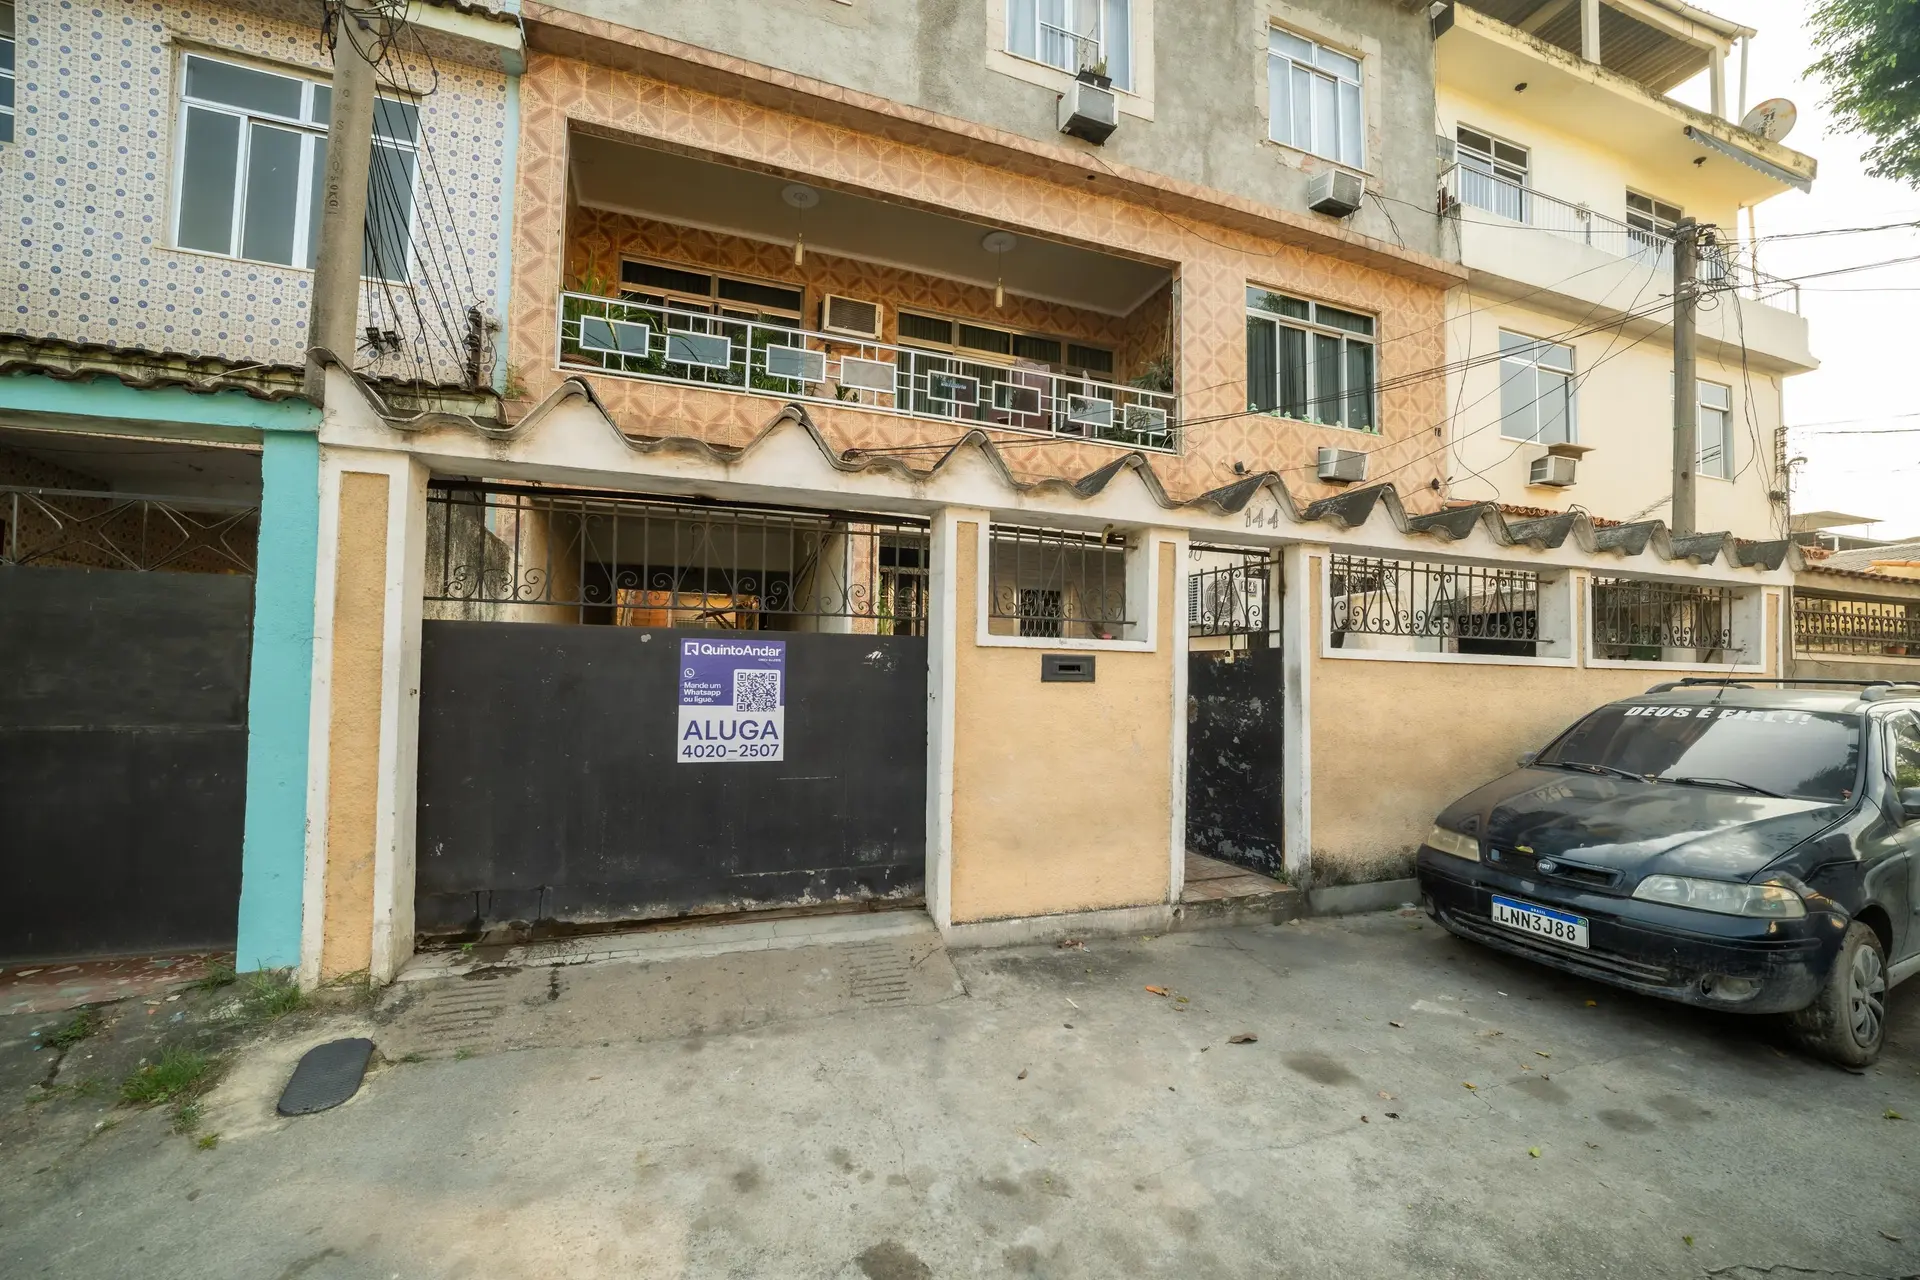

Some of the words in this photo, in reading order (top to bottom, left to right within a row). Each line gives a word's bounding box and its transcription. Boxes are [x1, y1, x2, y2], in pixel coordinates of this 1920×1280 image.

[1244, 507, 1279, 529] 144
[701, 644, 782, 656] QuintoAndar
[683, 689, 721, 697] Whatsapp
[694, 696, 714, 704] ligue.
[1623, 706, 1692, 718] DEUS
[1696, 706, 1715, 719] É
[683, 720, 779, 740] ALUGA
[682, 744, 779, 758] 4020-2507
[1530, 907, 1546, 915] BRASIL
[1500, 906, 1575, 940] LNN3J88
